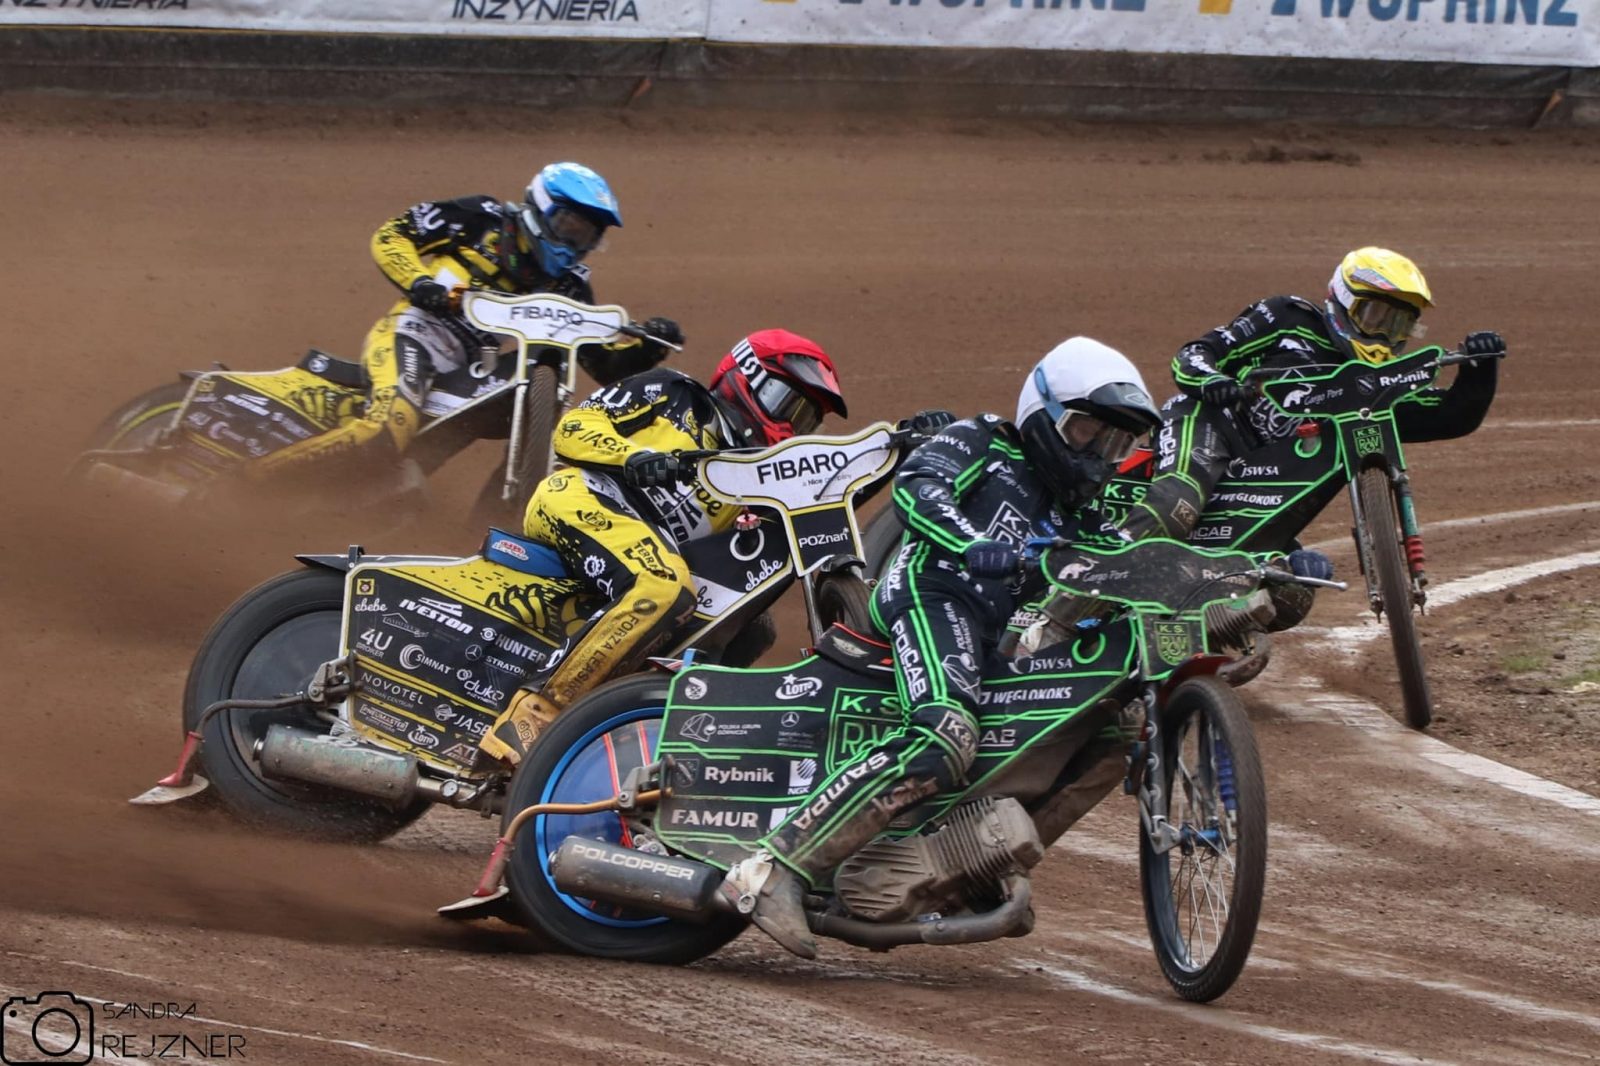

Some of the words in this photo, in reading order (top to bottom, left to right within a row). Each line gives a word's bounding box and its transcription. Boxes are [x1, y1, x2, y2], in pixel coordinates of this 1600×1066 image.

[511, 306, 583, 326] FIBARO
[756, 450, 849, 485] FIBARO
[808, 478, 823, 486] Nice
[355, 597, 389, 612] ebebe
[399, 599, 474, 635] IVESTON
[360, 628, 393, 651] 4U
[603, 613, 639, 650] FORZA
[494, 634, 547, 664] HUNTER
[416, 653, 452, 674] SIMNAT
[361, 672, 424, 705] NOVOTEL
[704, 766, 775, 784] Rybnik
[788, 787, 809, 795] NGK
[671, 809, 759, 827] FAMUR
[570, 844, 695, 880] POLCOPPER
